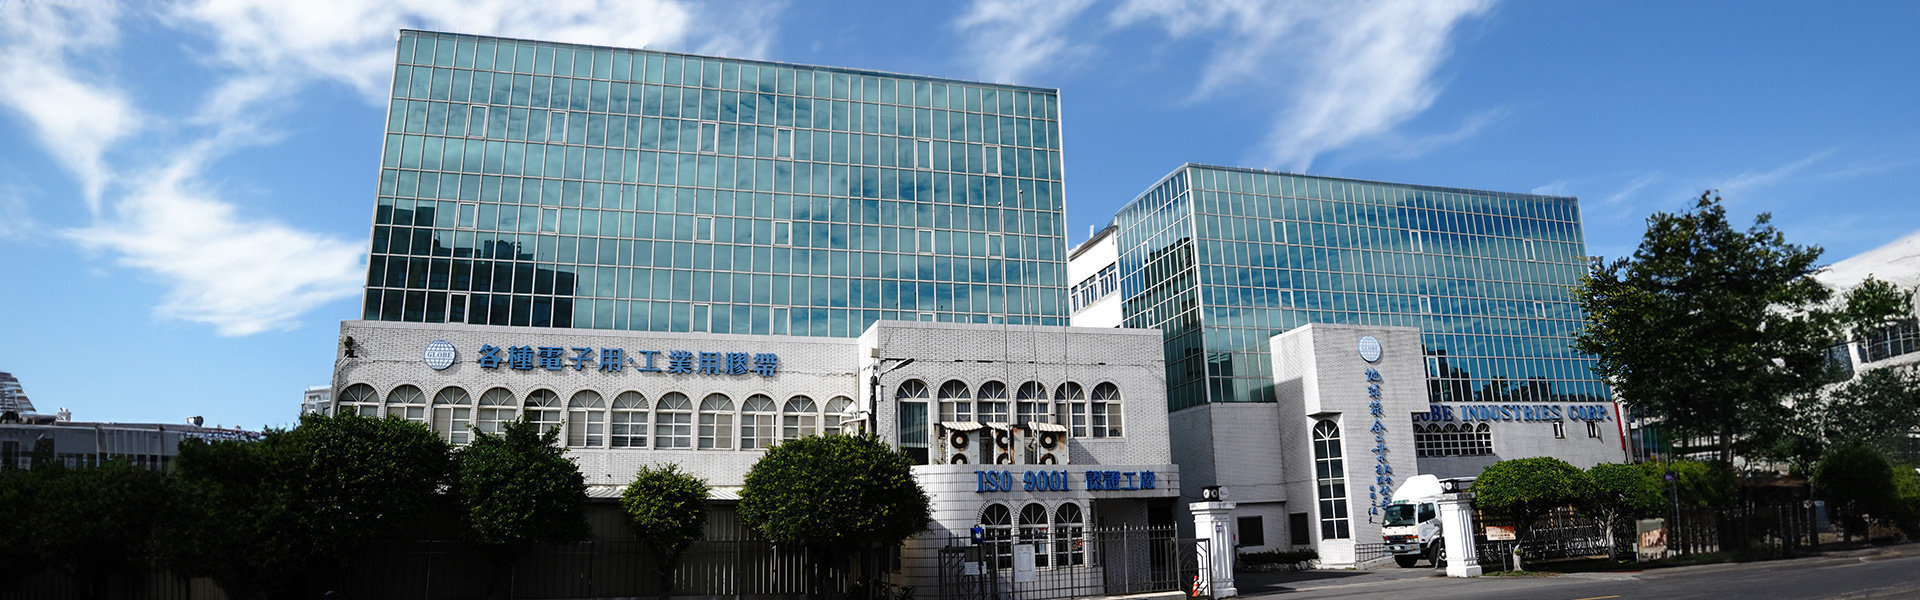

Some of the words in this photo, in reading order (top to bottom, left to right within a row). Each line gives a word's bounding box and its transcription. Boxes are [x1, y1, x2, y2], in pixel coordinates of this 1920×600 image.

[427, 350, 454, 359] GLOBE
[1459, 404, 1562, 422] INDUSTRIES
[1566, 404, 1613, 422] CORP.
[974, 469, 1013, 493] ISO
[1022, 469, 1071, 492] 9001
[1084, 469, 1156, 491] 認證工廠
